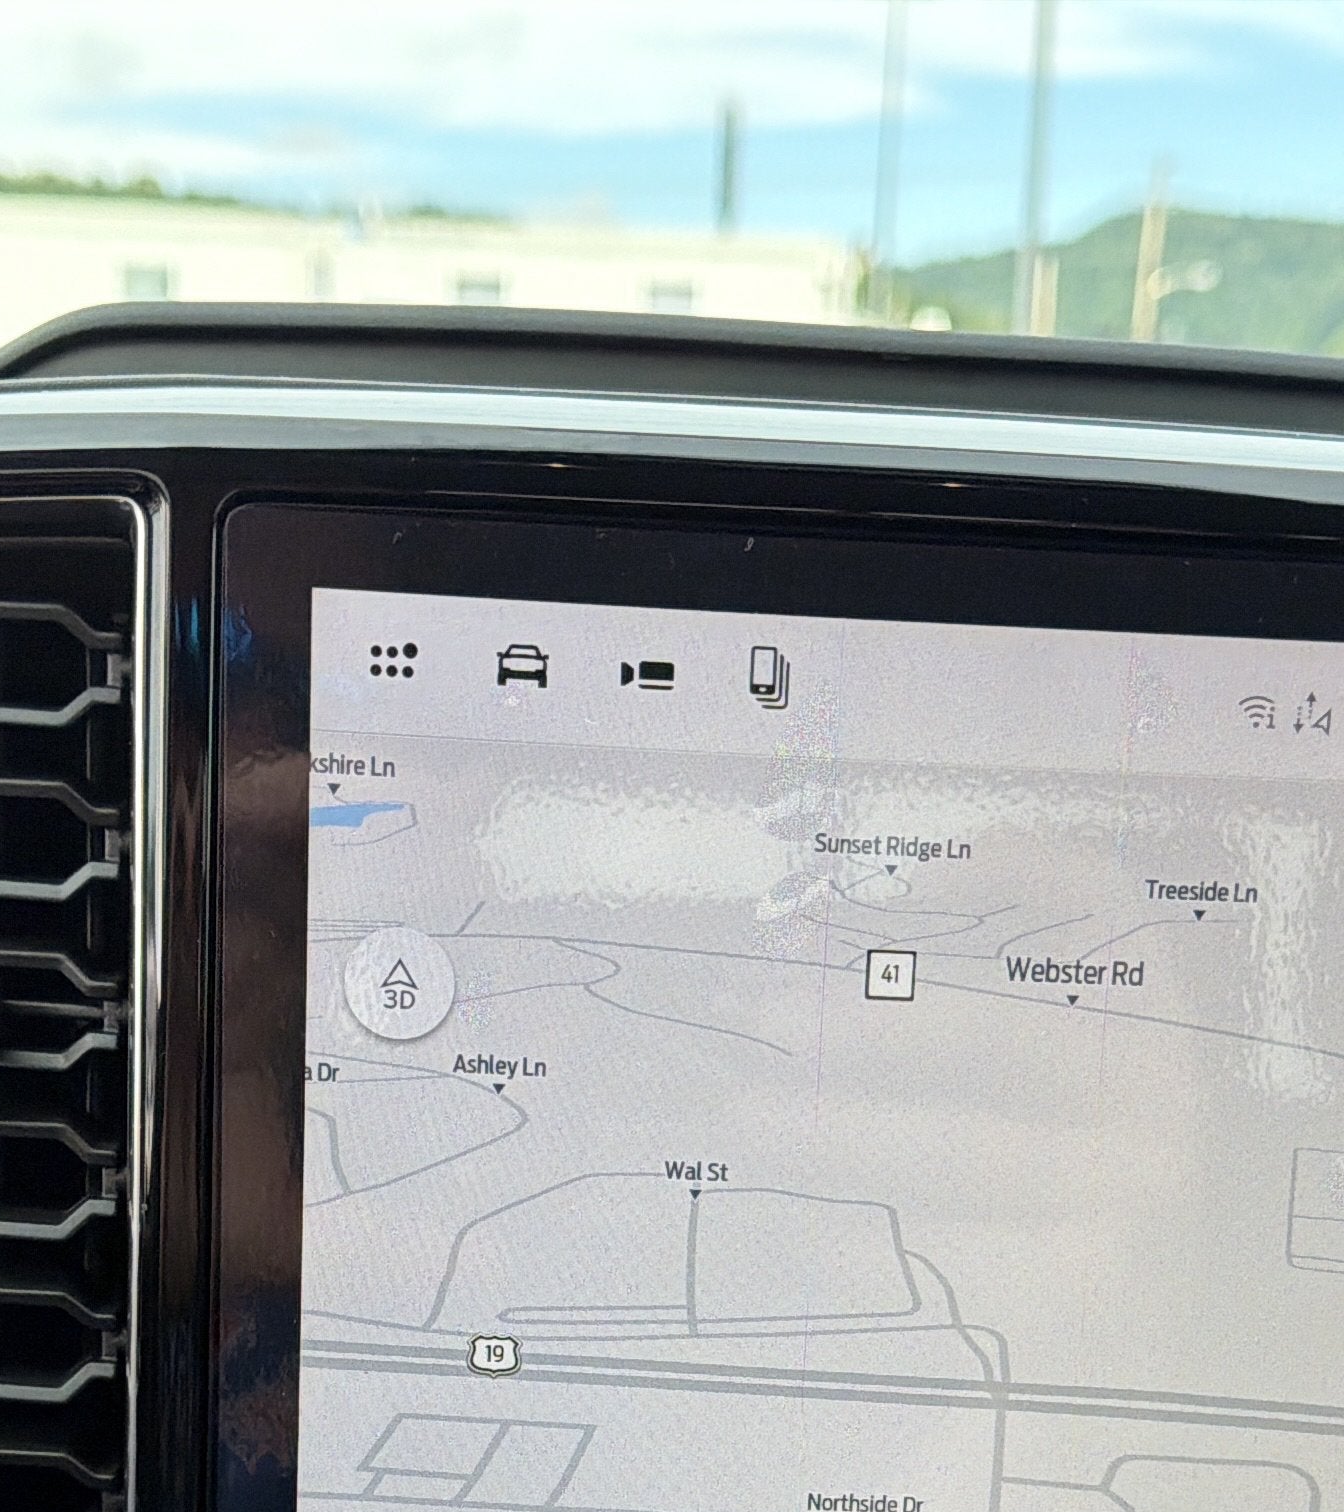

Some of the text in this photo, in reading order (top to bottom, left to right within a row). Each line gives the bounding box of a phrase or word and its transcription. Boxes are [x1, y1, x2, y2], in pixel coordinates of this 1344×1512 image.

[371, 756, 397, 779] Ln
[813, 833, 972, 862] Sunset Ridge Ln
[1145, 880, 1259, 904] Treeside Ln
[880, 965, 902, 985] 41
[1006, 957, 1145, 987] Webster Rd
[382, 990, 416, 1010] 3D
[317, 1062, 341, 1083] Dr
[452, 1052, 548, 1080] Ashley Ln
[664, 1161, 729, 1183] Wal St
[485, 1344, 504, 1363] 19
